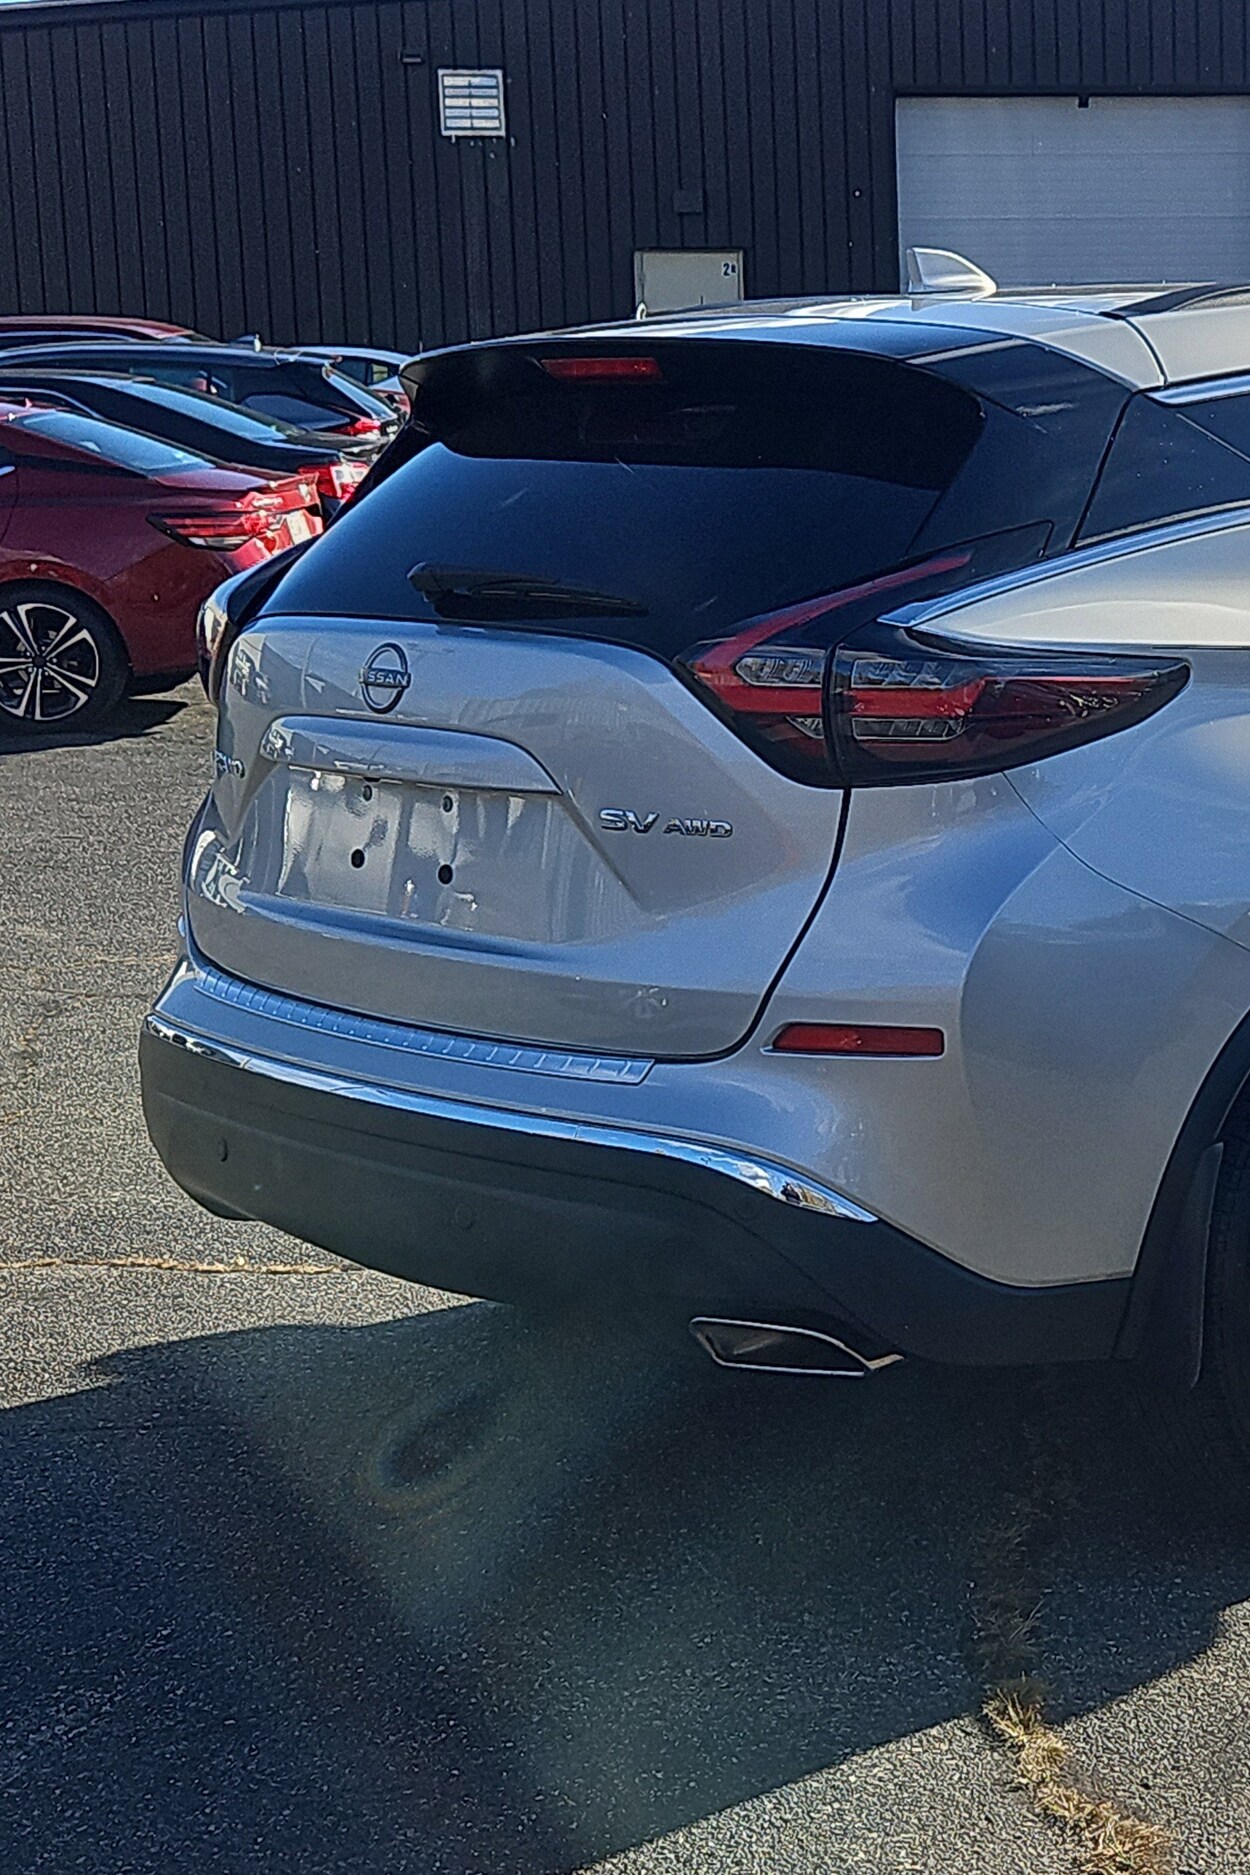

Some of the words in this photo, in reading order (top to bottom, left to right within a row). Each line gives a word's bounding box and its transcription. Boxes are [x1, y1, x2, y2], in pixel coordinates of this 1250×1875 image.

[361, 669, 409, 687] SSAN
[599, 807, 660, 834] SV
[663, 818, 733, 838] AWD
